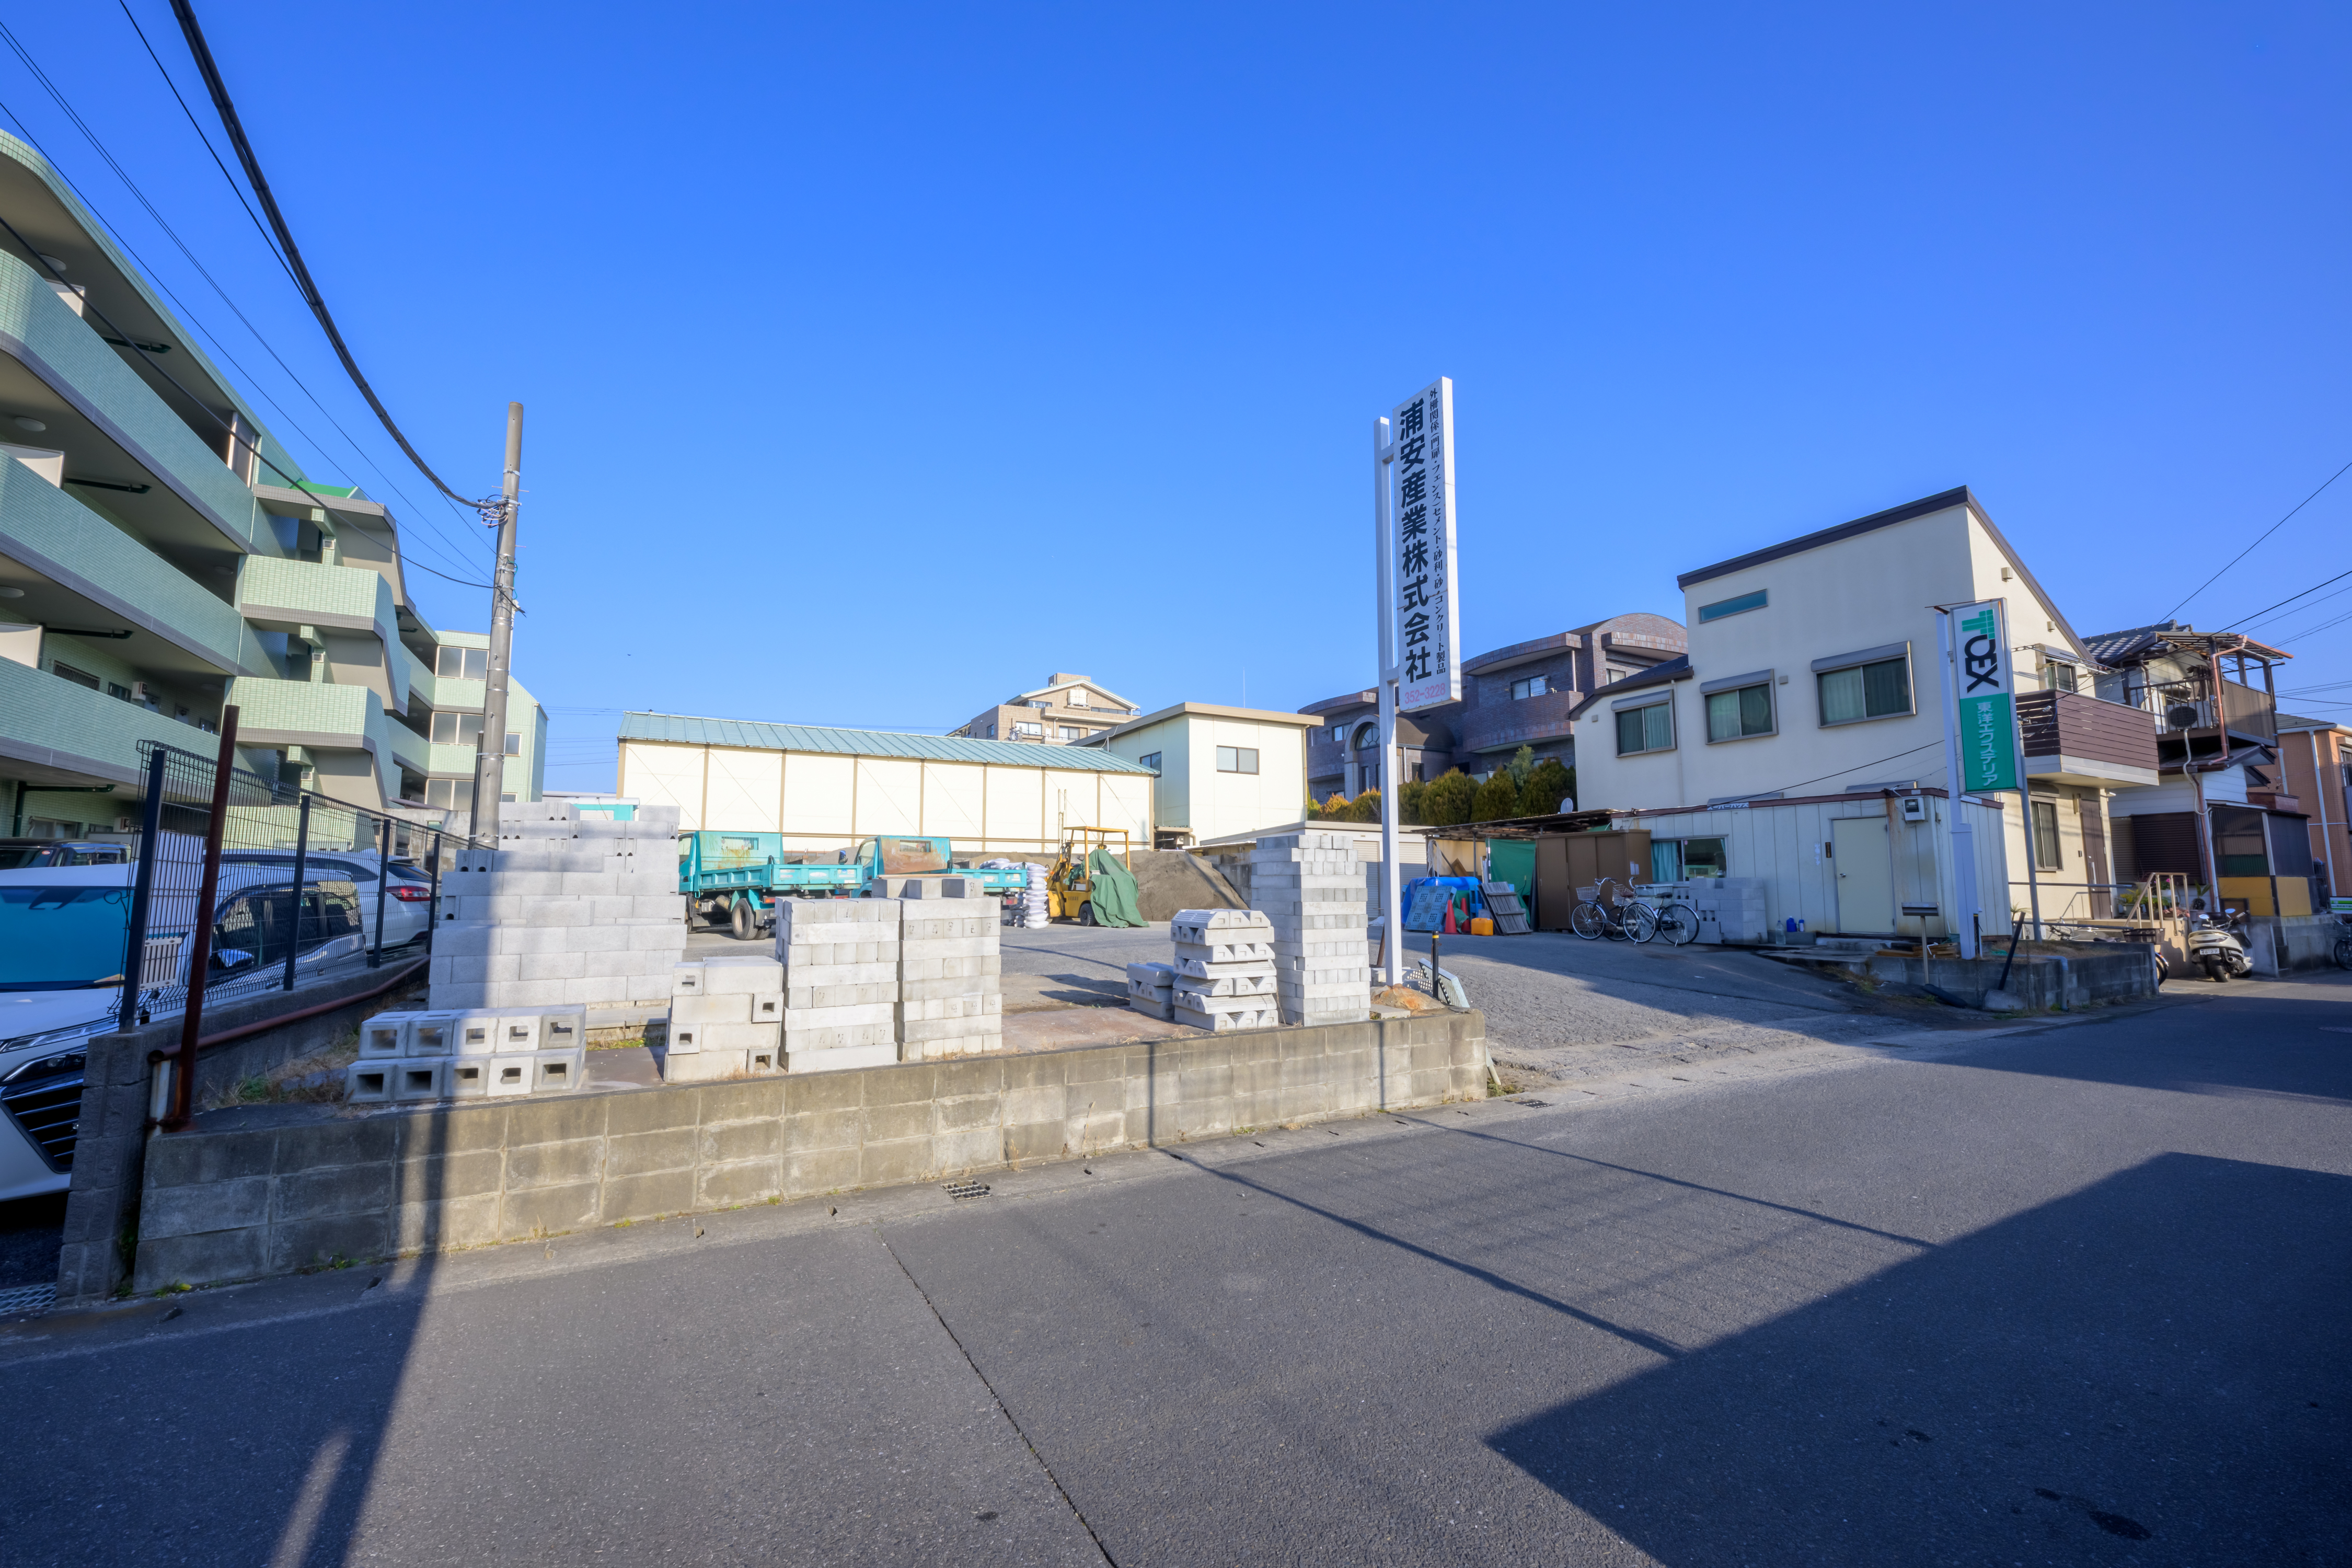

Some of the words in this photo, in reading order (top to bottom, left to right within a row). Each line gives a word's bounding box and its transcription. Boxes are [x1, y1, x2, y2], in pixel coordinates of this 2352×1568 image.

[1399, 397, 1432, 684] 浦安産業株式会社
[1404, 683, 1446, 705] 352-3228
[1962, 608, 1999, 694] TOEX
[1976, 701, 1998, 787] 東洋エクステリア
